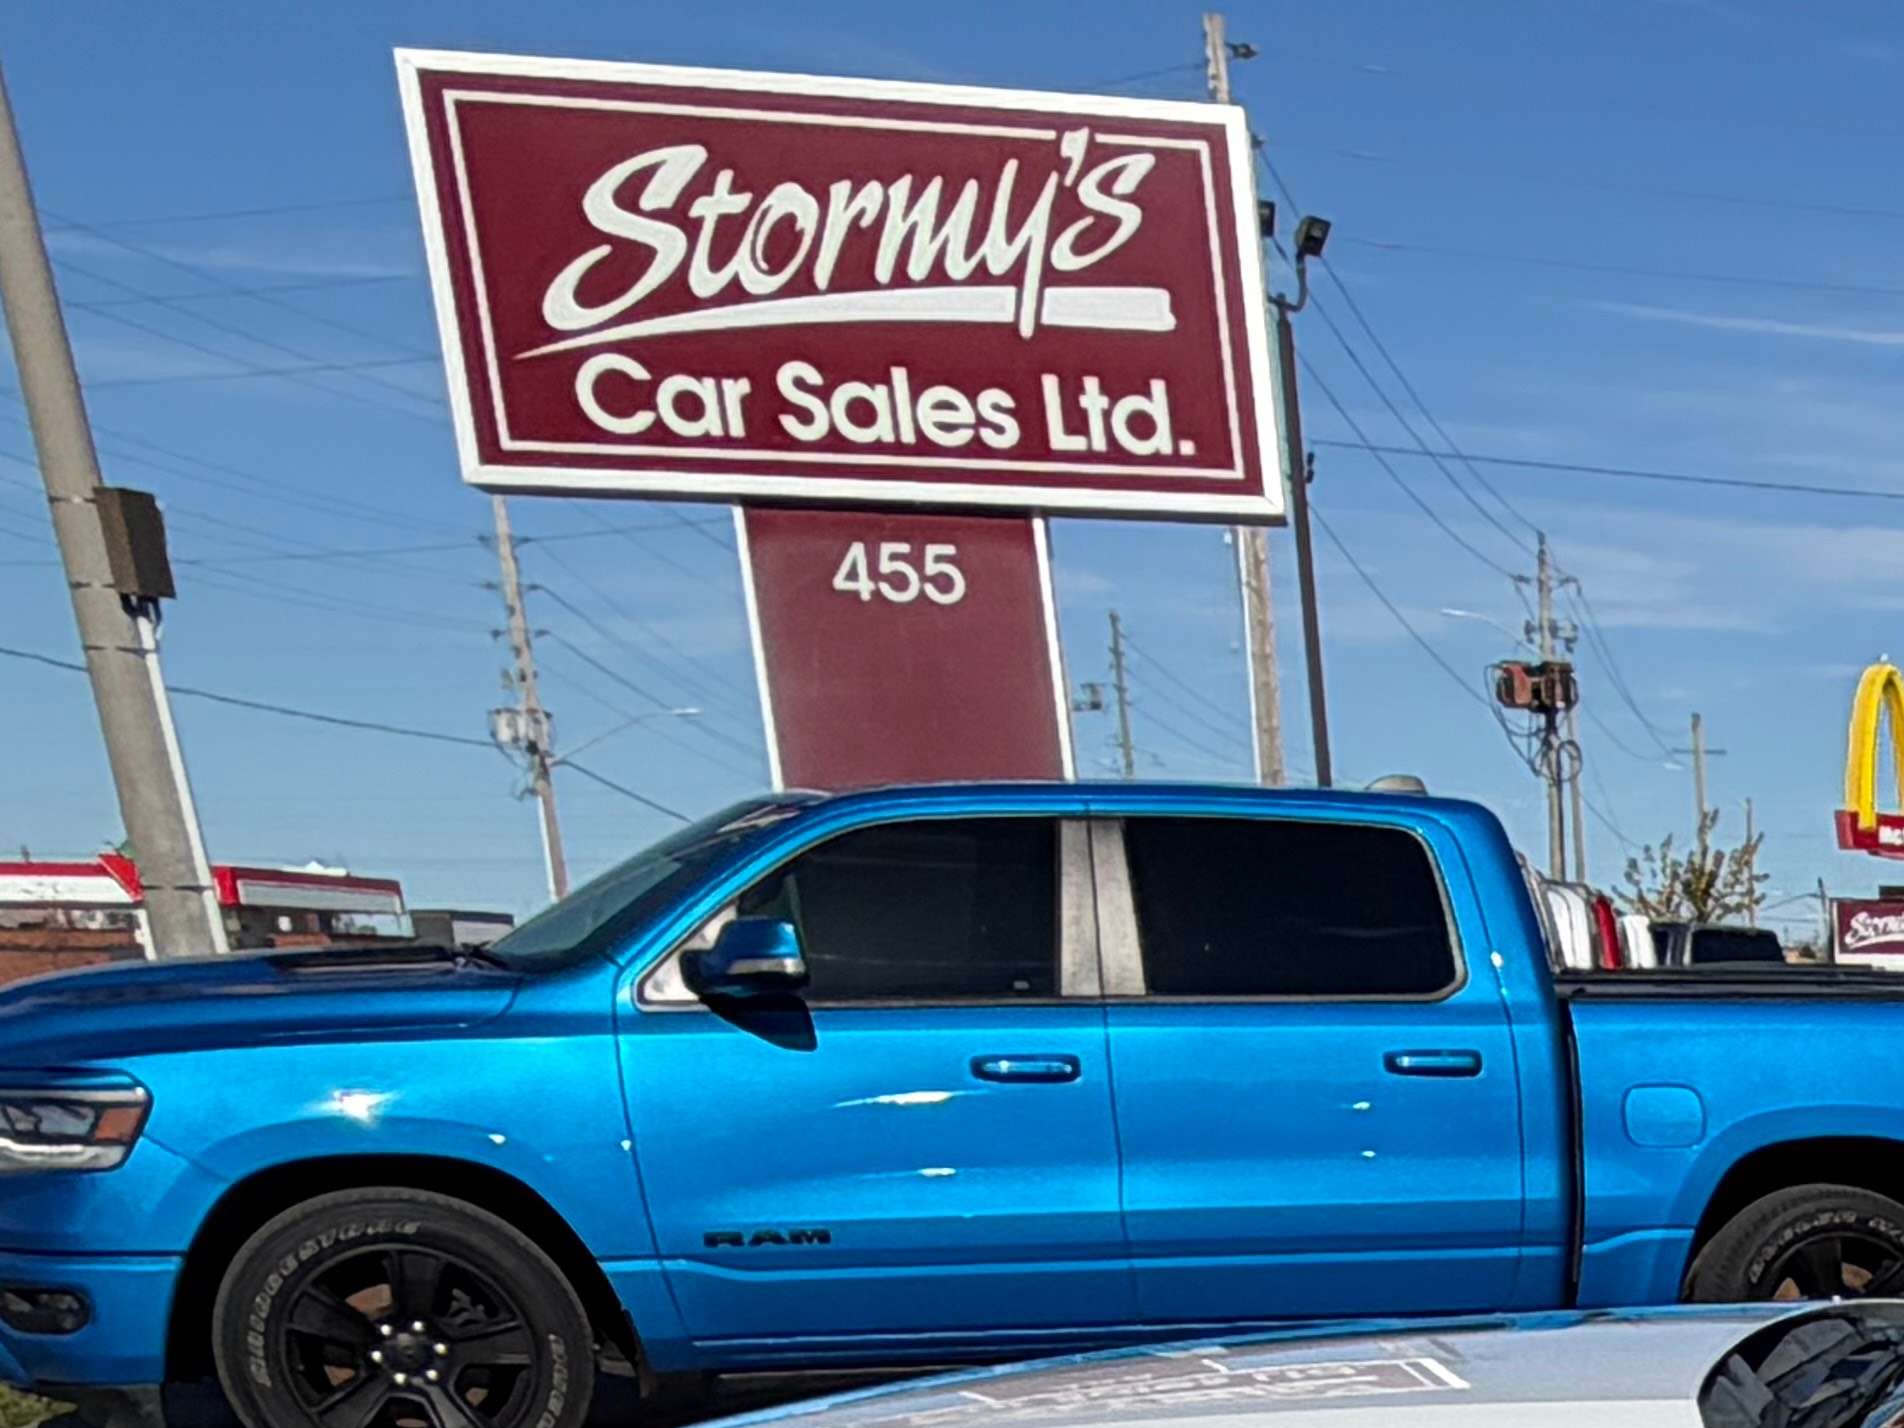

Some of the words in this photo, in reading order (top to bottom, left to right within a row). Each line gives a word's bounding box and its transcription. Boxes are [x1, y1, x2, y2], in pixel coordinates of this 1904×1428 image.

[542, 128, 1156, 339] Stormy's
[574, 352, 752, 438] Car
[776, 360, 1021, 450] Sales
[1040, 373, 1196, 456] Ltd.
[832, 541, 967, 604] 455
[703, 1228, 832, 1248] RAM
